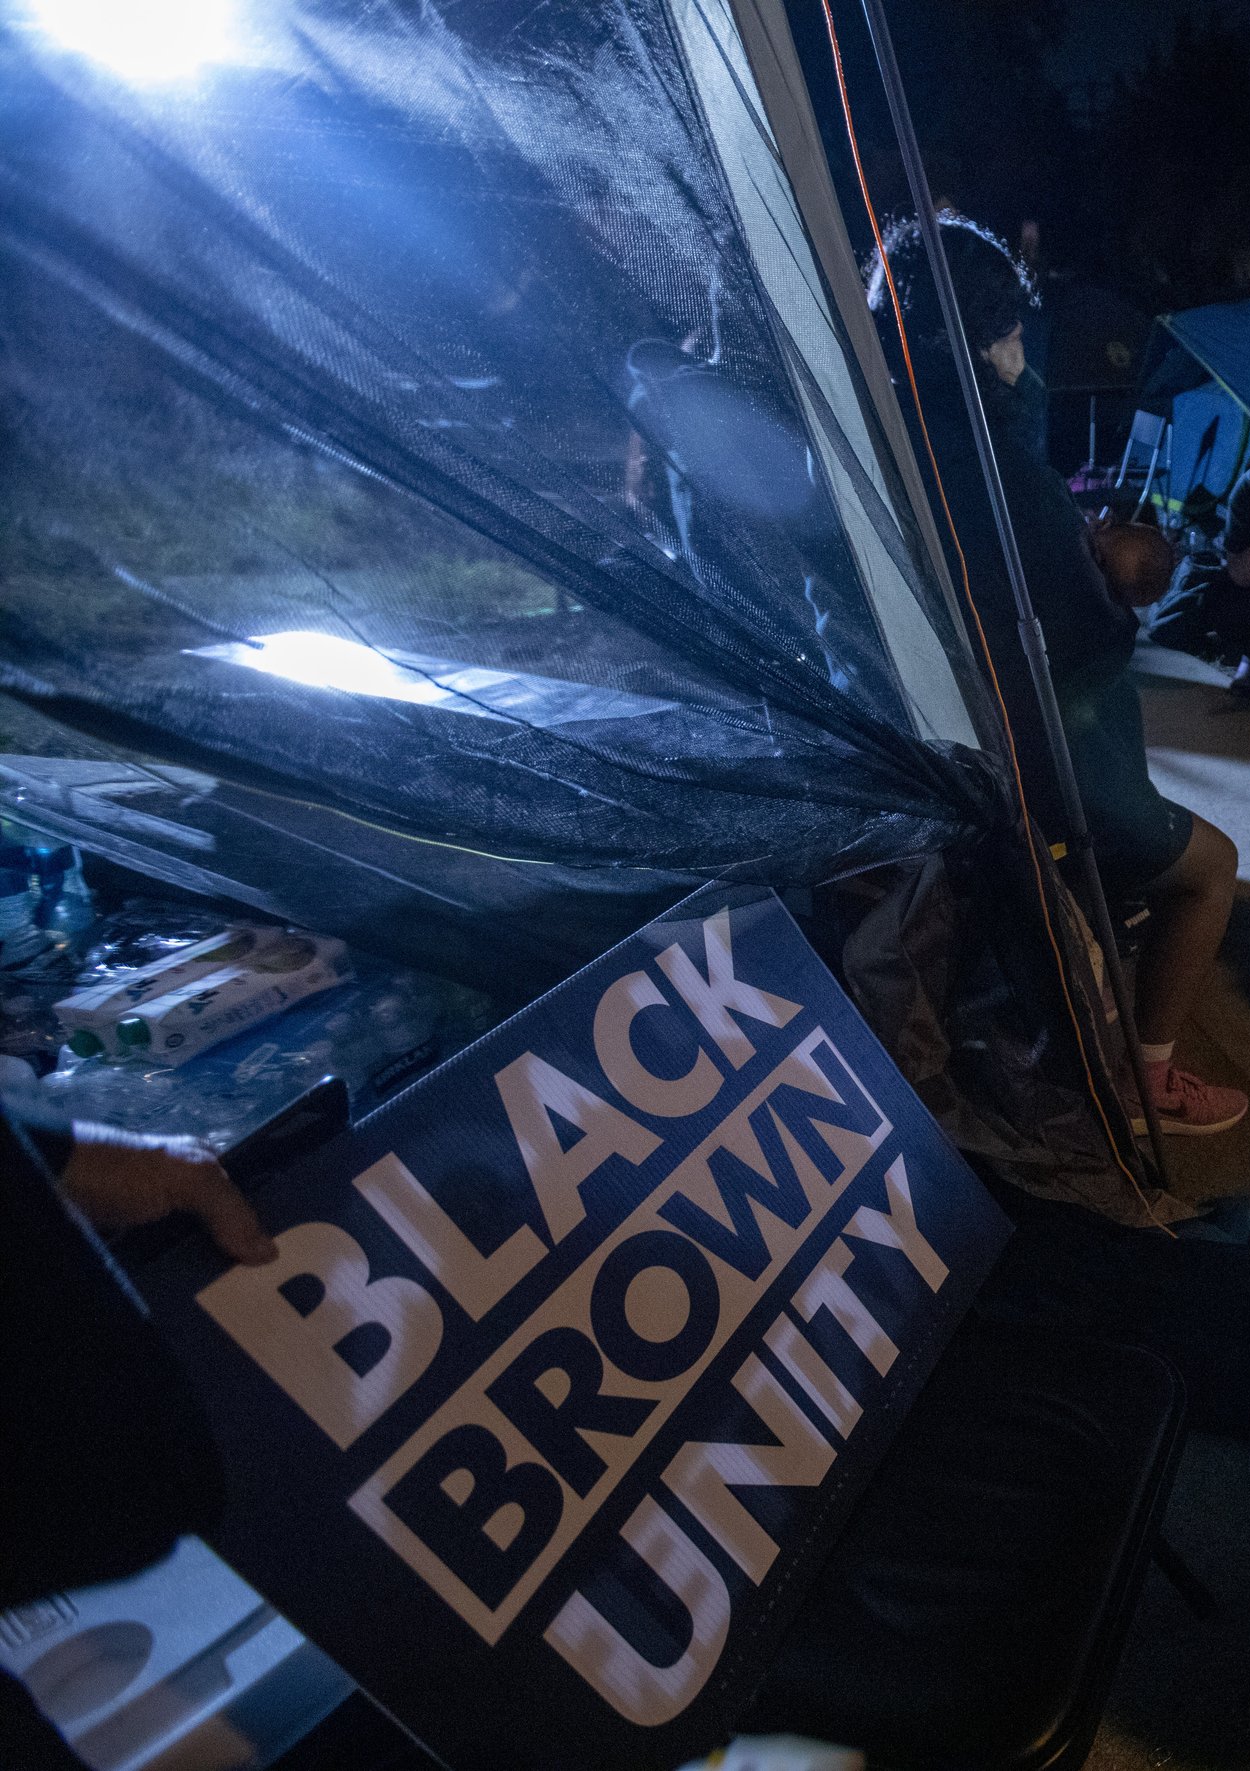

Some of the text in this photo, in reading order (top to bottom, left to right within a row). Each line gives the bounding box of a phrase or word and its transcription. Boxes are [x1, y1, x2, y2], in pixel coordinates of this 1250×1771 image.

[195, 906, 803, 1451] BLACK
[382, 1041, 879, 1613] BROWN
[543, 1153, 950, 1727] UNITY
